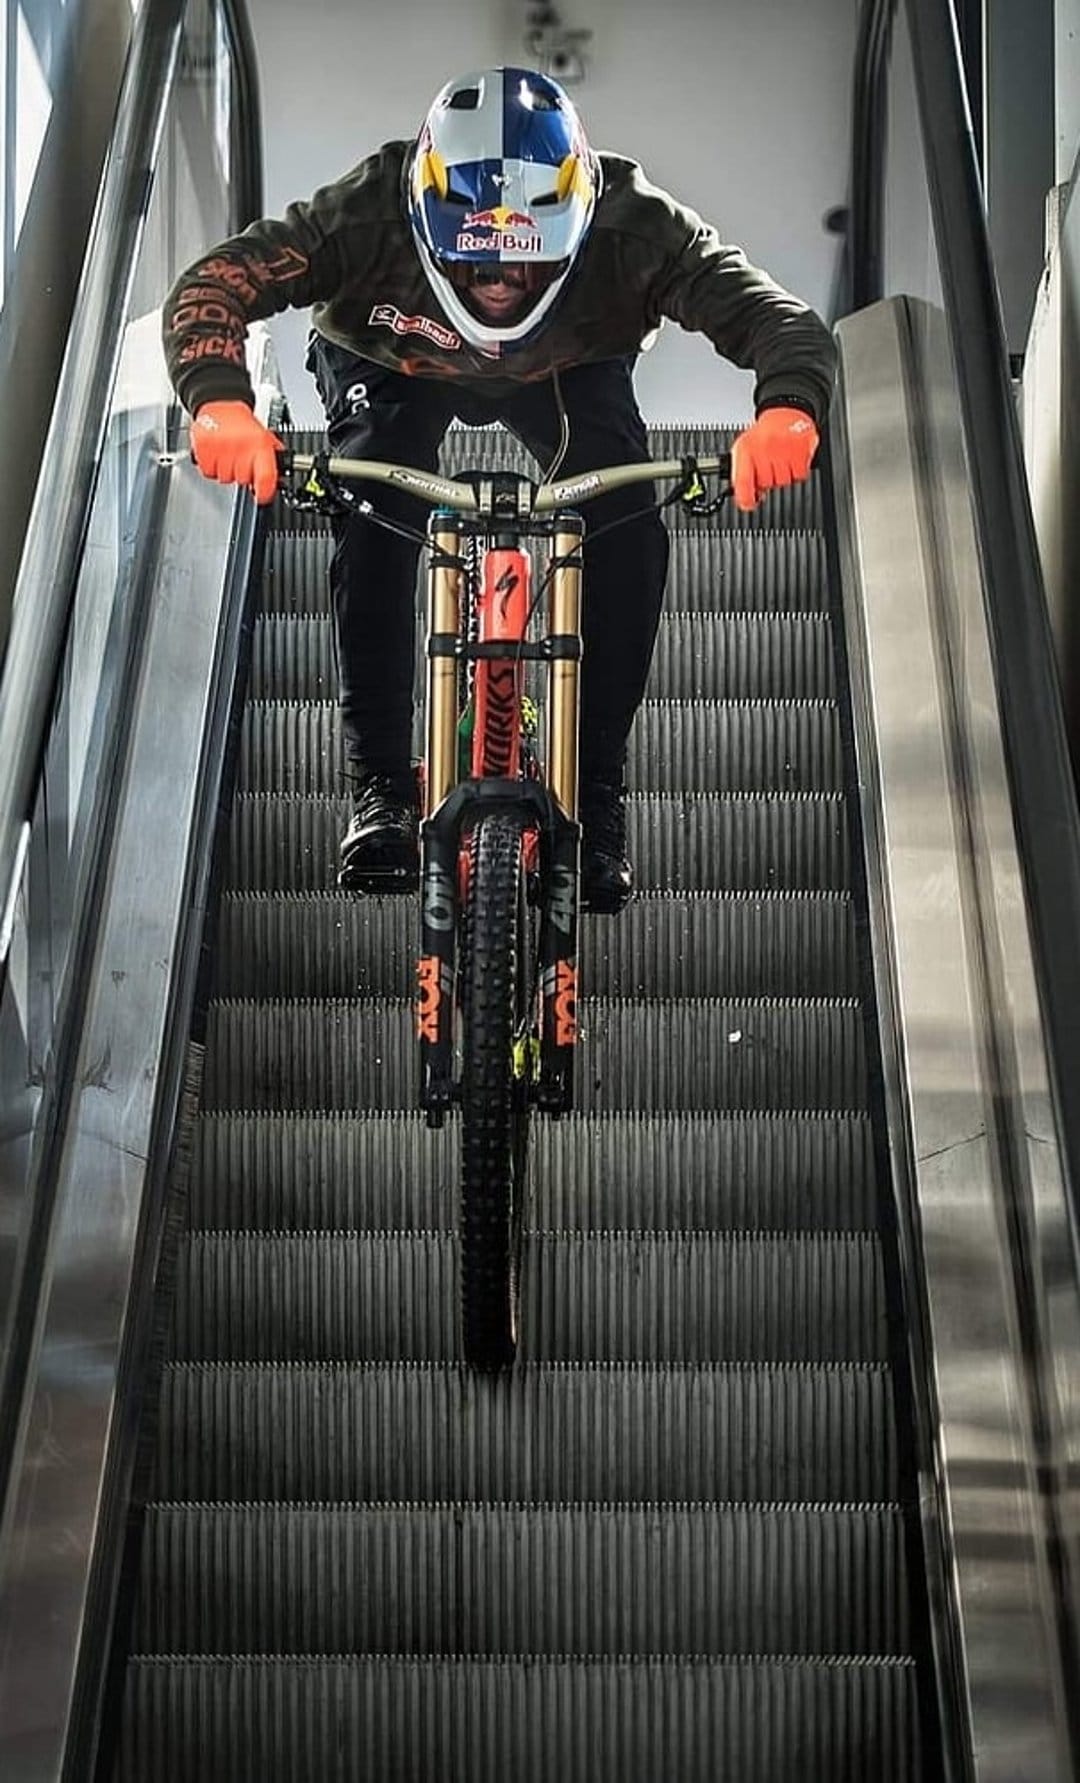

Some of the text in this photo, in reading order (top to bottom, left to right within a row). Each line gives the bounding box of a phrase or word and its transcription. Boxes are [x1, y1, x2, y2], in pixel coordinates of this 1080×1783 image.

[457, 232, 543, 252] Red Bull
[179, 335, 243, 363] SICK
[416, 956, 442, 1044] FOX
[555, 959, 578, 1047] FOX
